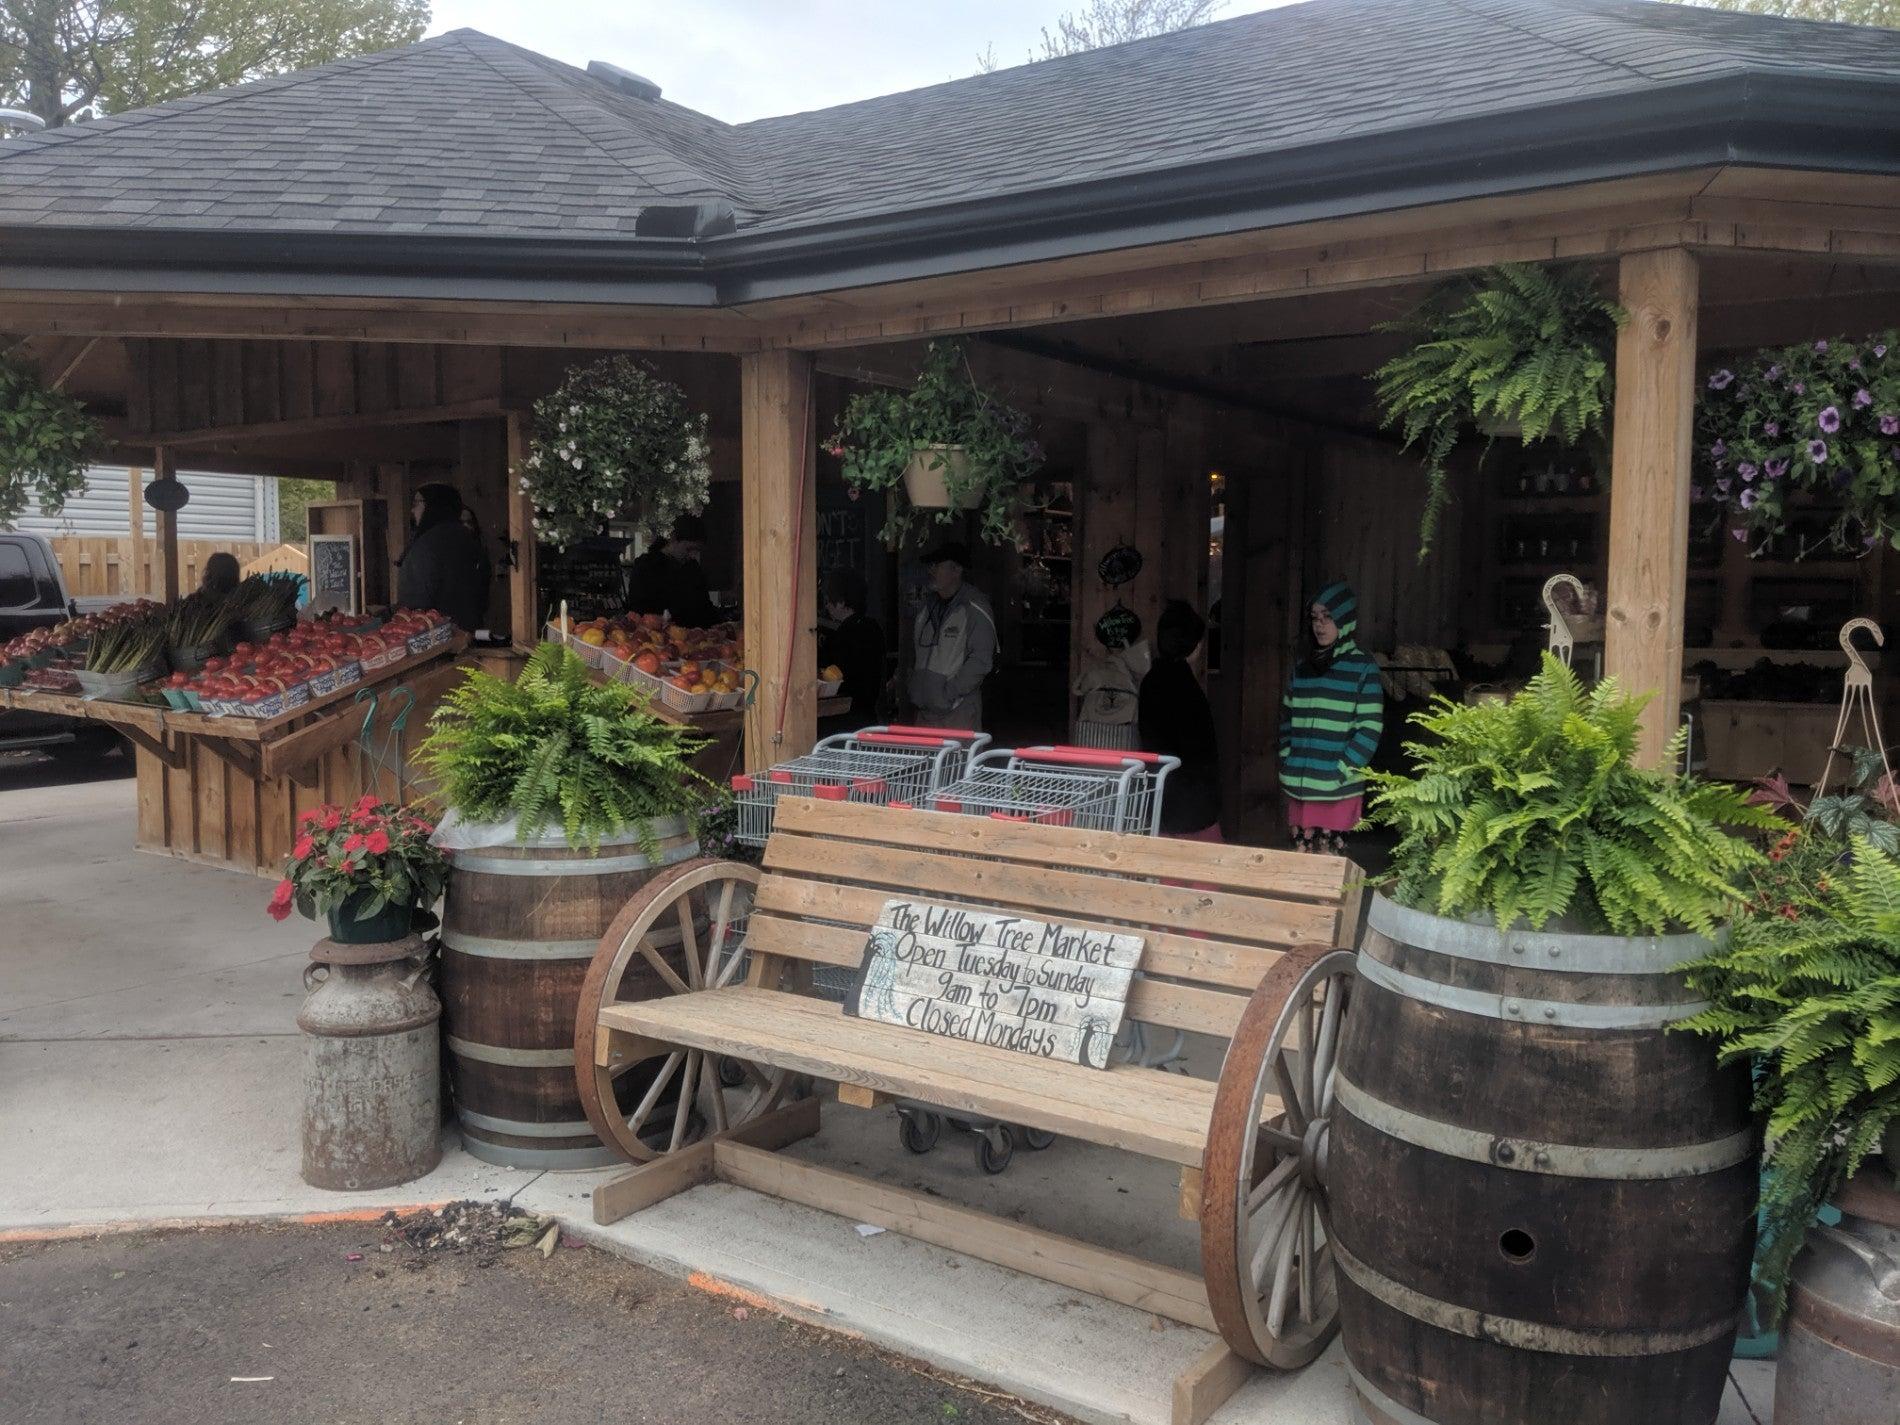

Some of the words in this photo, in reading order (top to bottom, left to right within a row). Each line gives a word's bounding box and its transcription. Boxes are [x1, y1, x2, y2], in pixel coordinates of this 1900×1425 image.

[891, 903, 920, 931] The
[924, 905, 986, 944] Willow
[995, 918, 1034, 951] Tree
[1039, 922, 1116, 966] Market
[895, 931, 946, 977] Open
[955, 942, 1020, 994] Tuesday
[1023, 956, 1035, 984] to
[1036, 960, 1095, 1009] Sunday
[905, 998, 975, 1040] Closed
[973, 1010, 1056, 1056] Mondays
[938, 972, 972, 1003] 9am
[979, 980, 999, 1010] to
[1013, 985, 1057, 1036] 7pm
